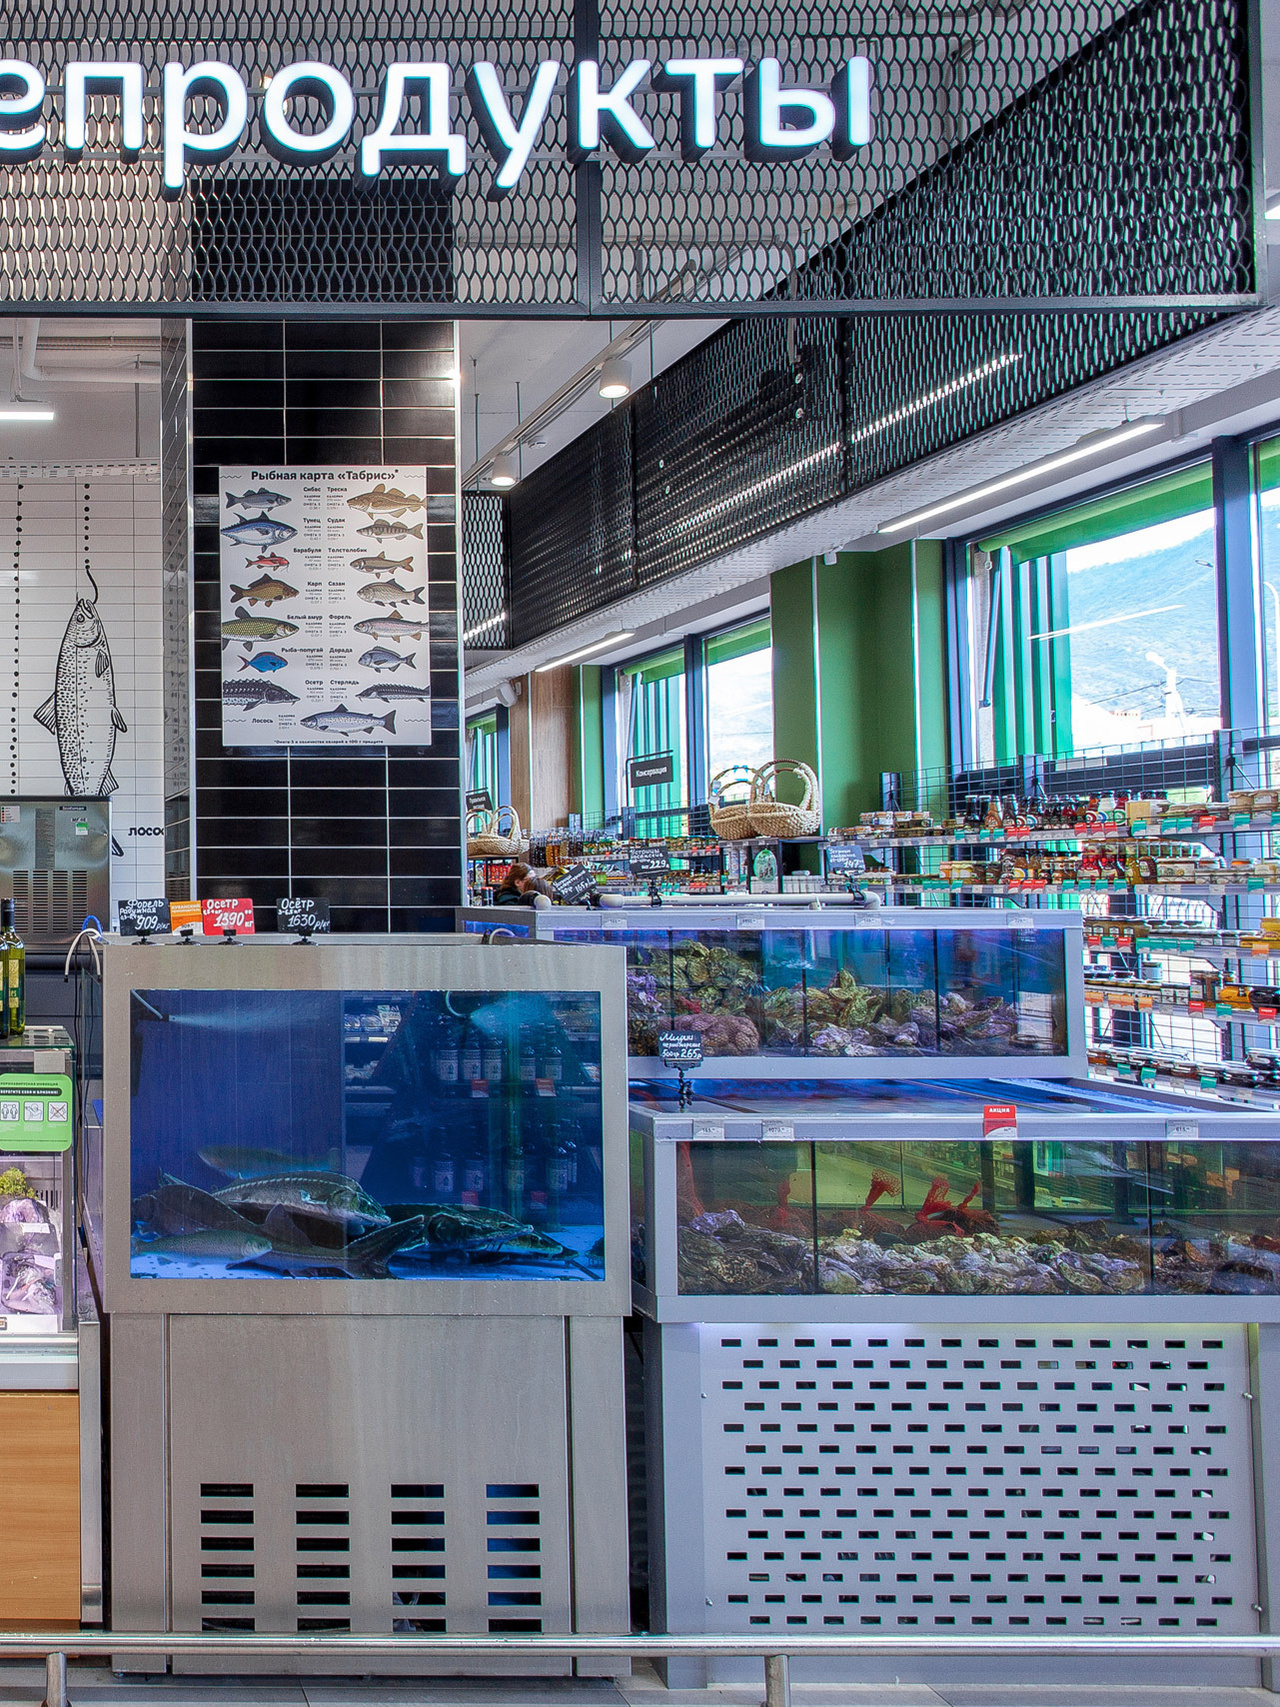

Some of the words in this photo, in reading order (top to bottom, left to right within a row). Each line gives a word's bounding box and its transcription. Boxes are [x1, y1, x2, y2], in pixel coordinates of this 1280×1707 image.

[251, 471, 297, 482] Рыбная
[299, 473, 334, 482] карта
[127, 899, 164, 908] Форель
[206, 899, 239, 909] Осетр
[213, 912, 245, 927] 1390
[288, 914, 316, 927] 1630
